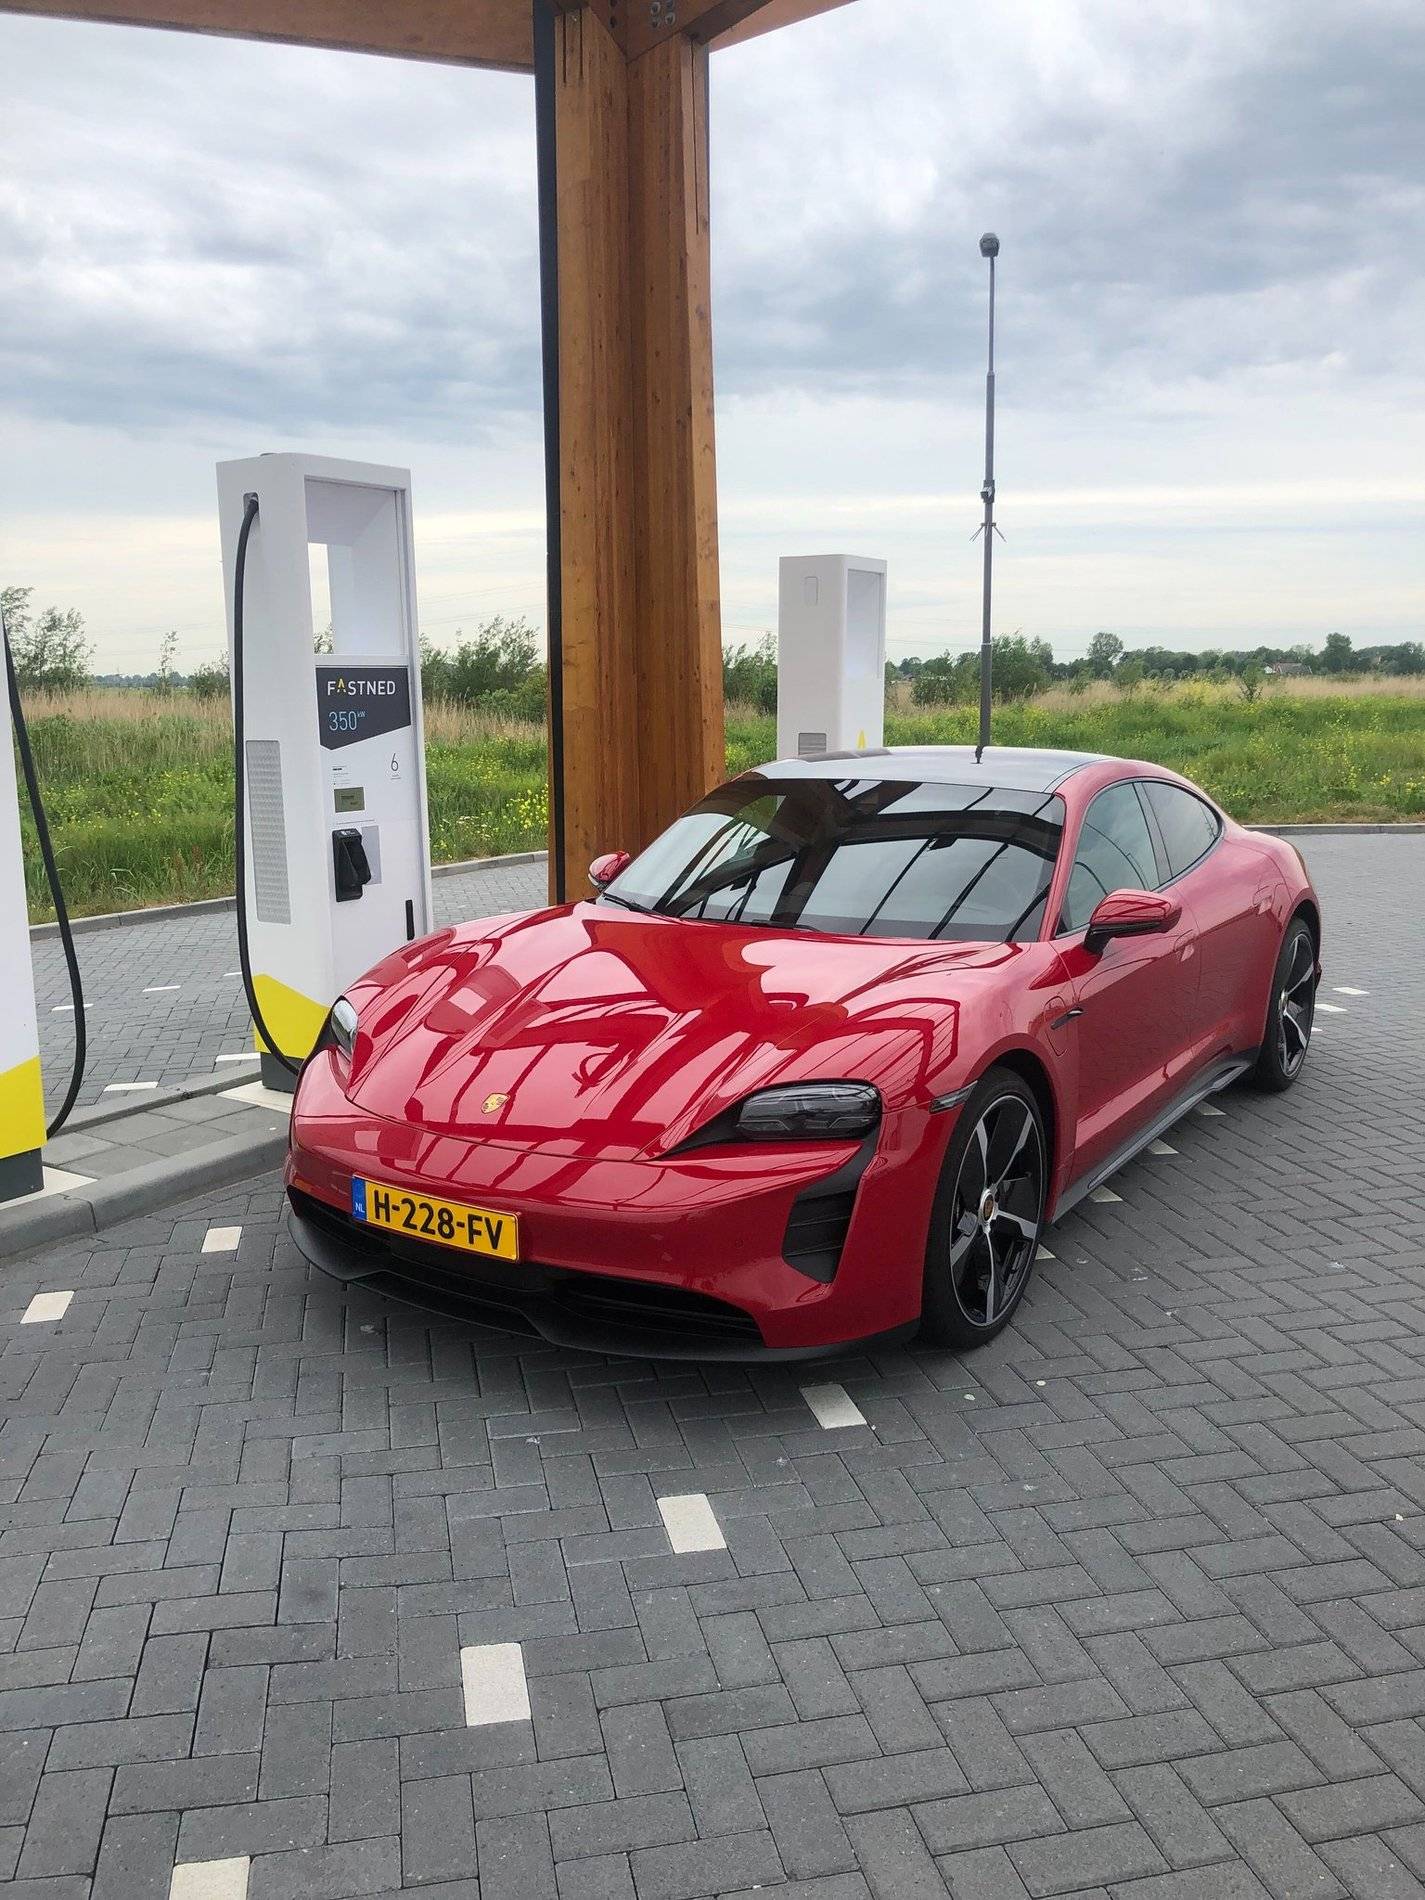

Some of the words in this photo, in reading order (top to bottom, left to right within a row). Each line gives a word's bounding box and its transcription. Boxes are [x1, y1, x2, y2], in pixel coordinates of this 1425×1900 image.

[327, 678, 396, 696] FASTNED
[391, 753, 399, 771] 6
[354, 1201, 366, 1214] NL
[373, 1189, 503, 1250] H-228-FV
